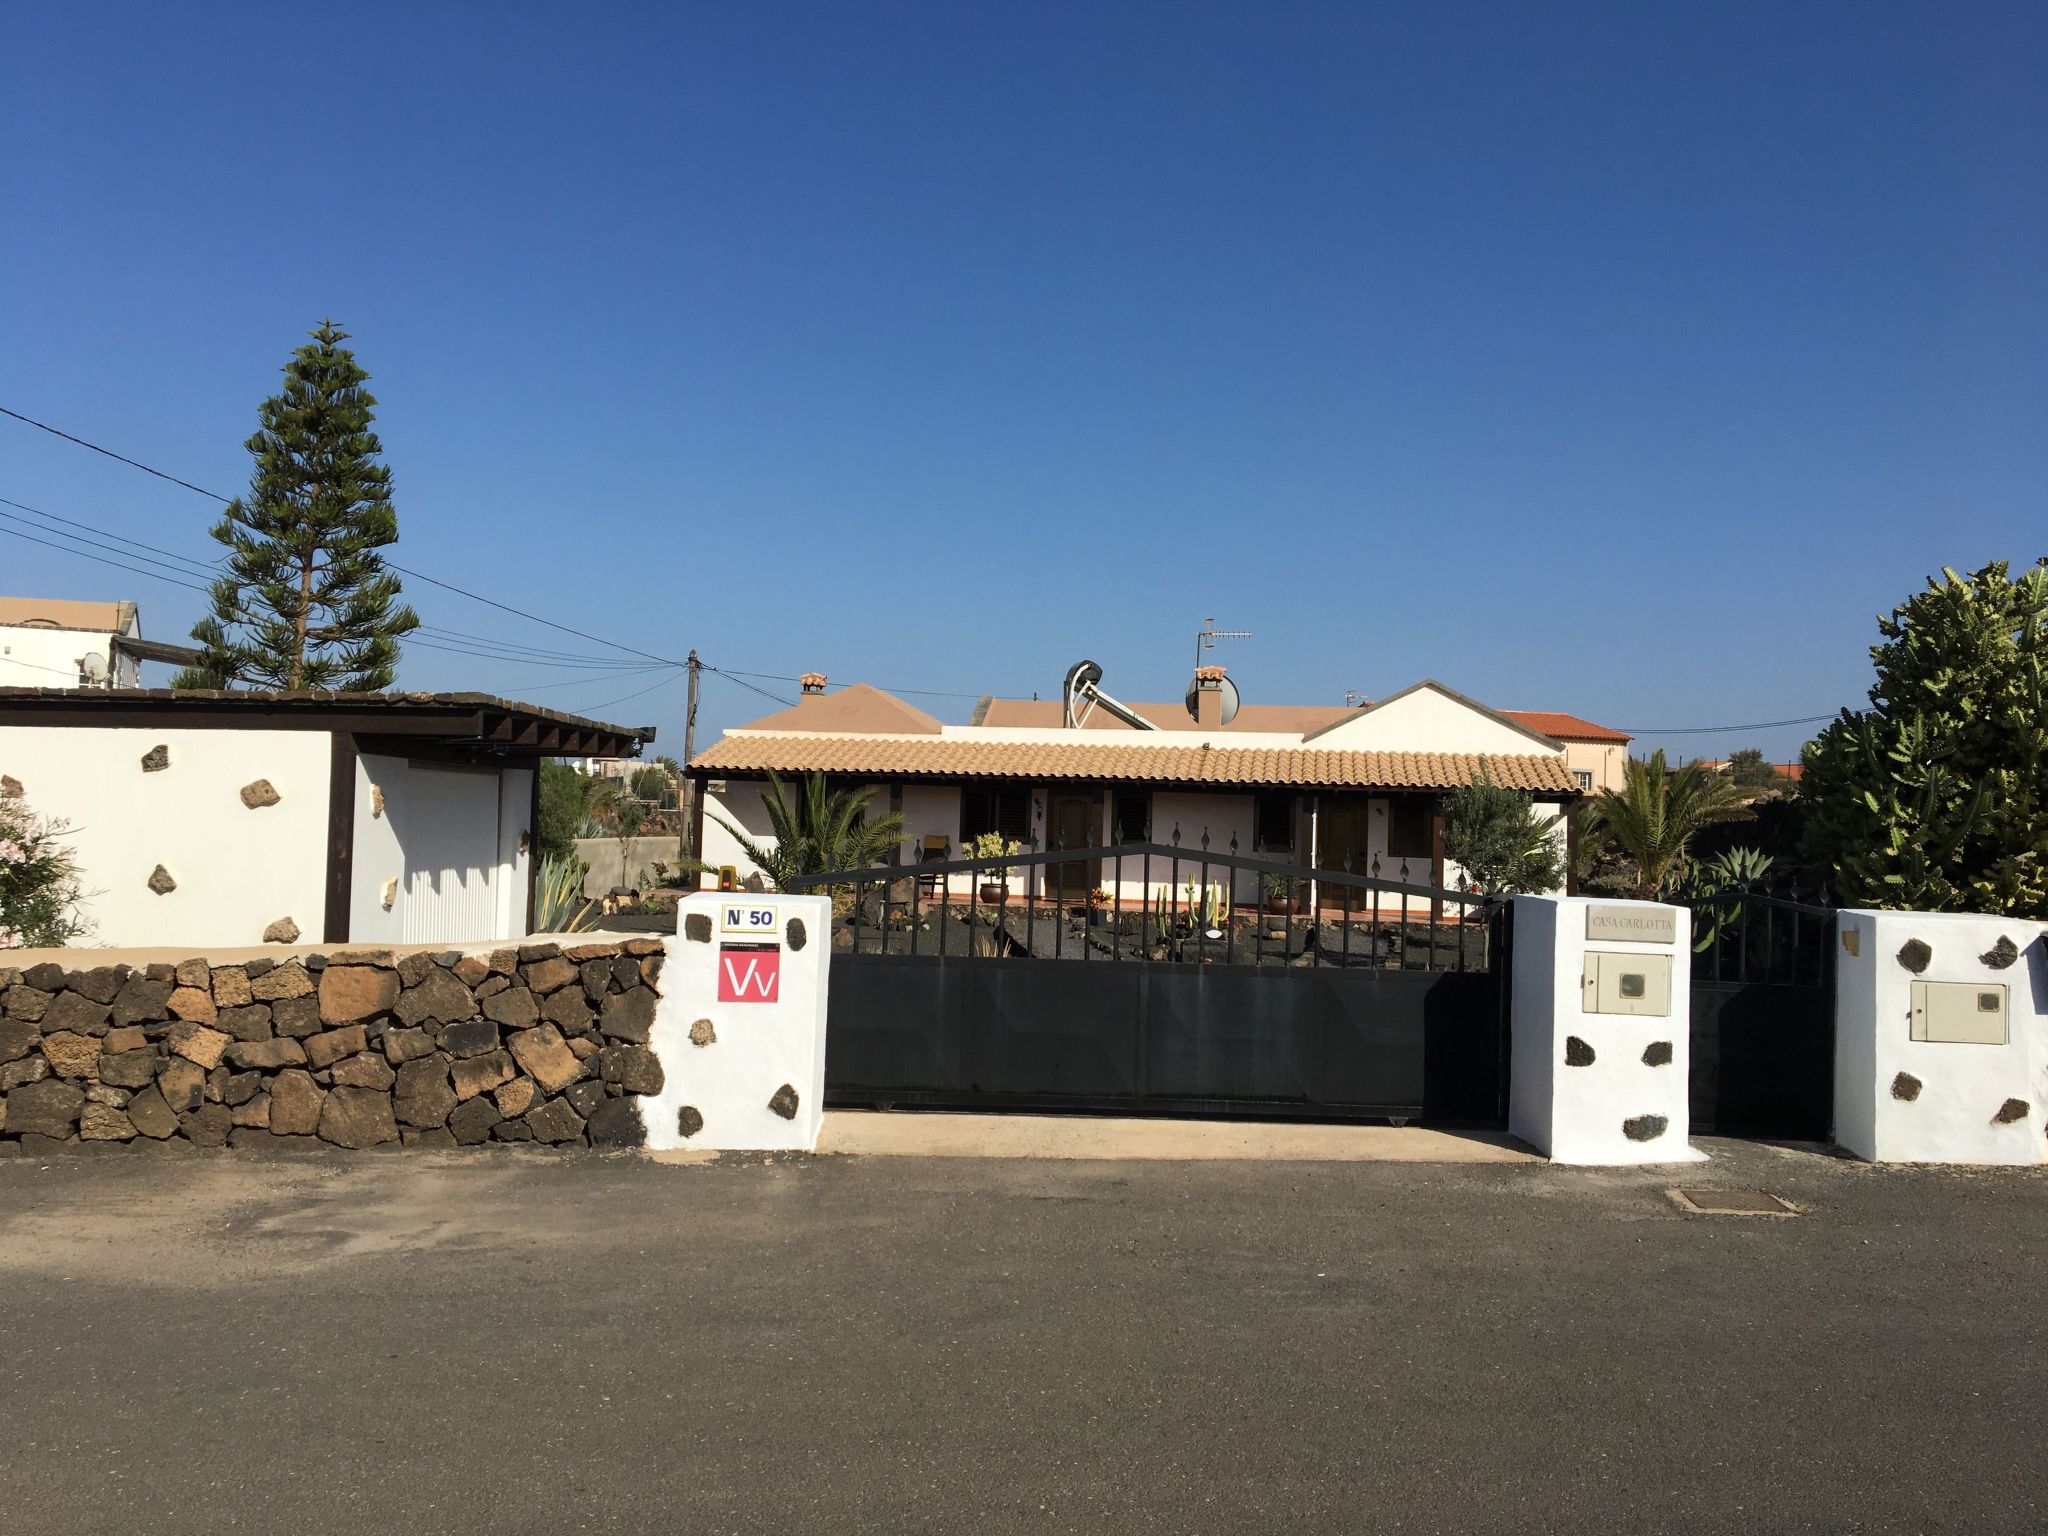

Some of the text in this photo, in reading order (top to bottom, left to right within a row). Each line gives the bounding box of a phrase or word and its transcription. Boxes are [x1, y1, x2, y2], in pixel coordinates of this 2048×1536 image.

[750, 910, 773, 926] 50
[1592, 916, 1673, 931] CASA CARLOTTA
